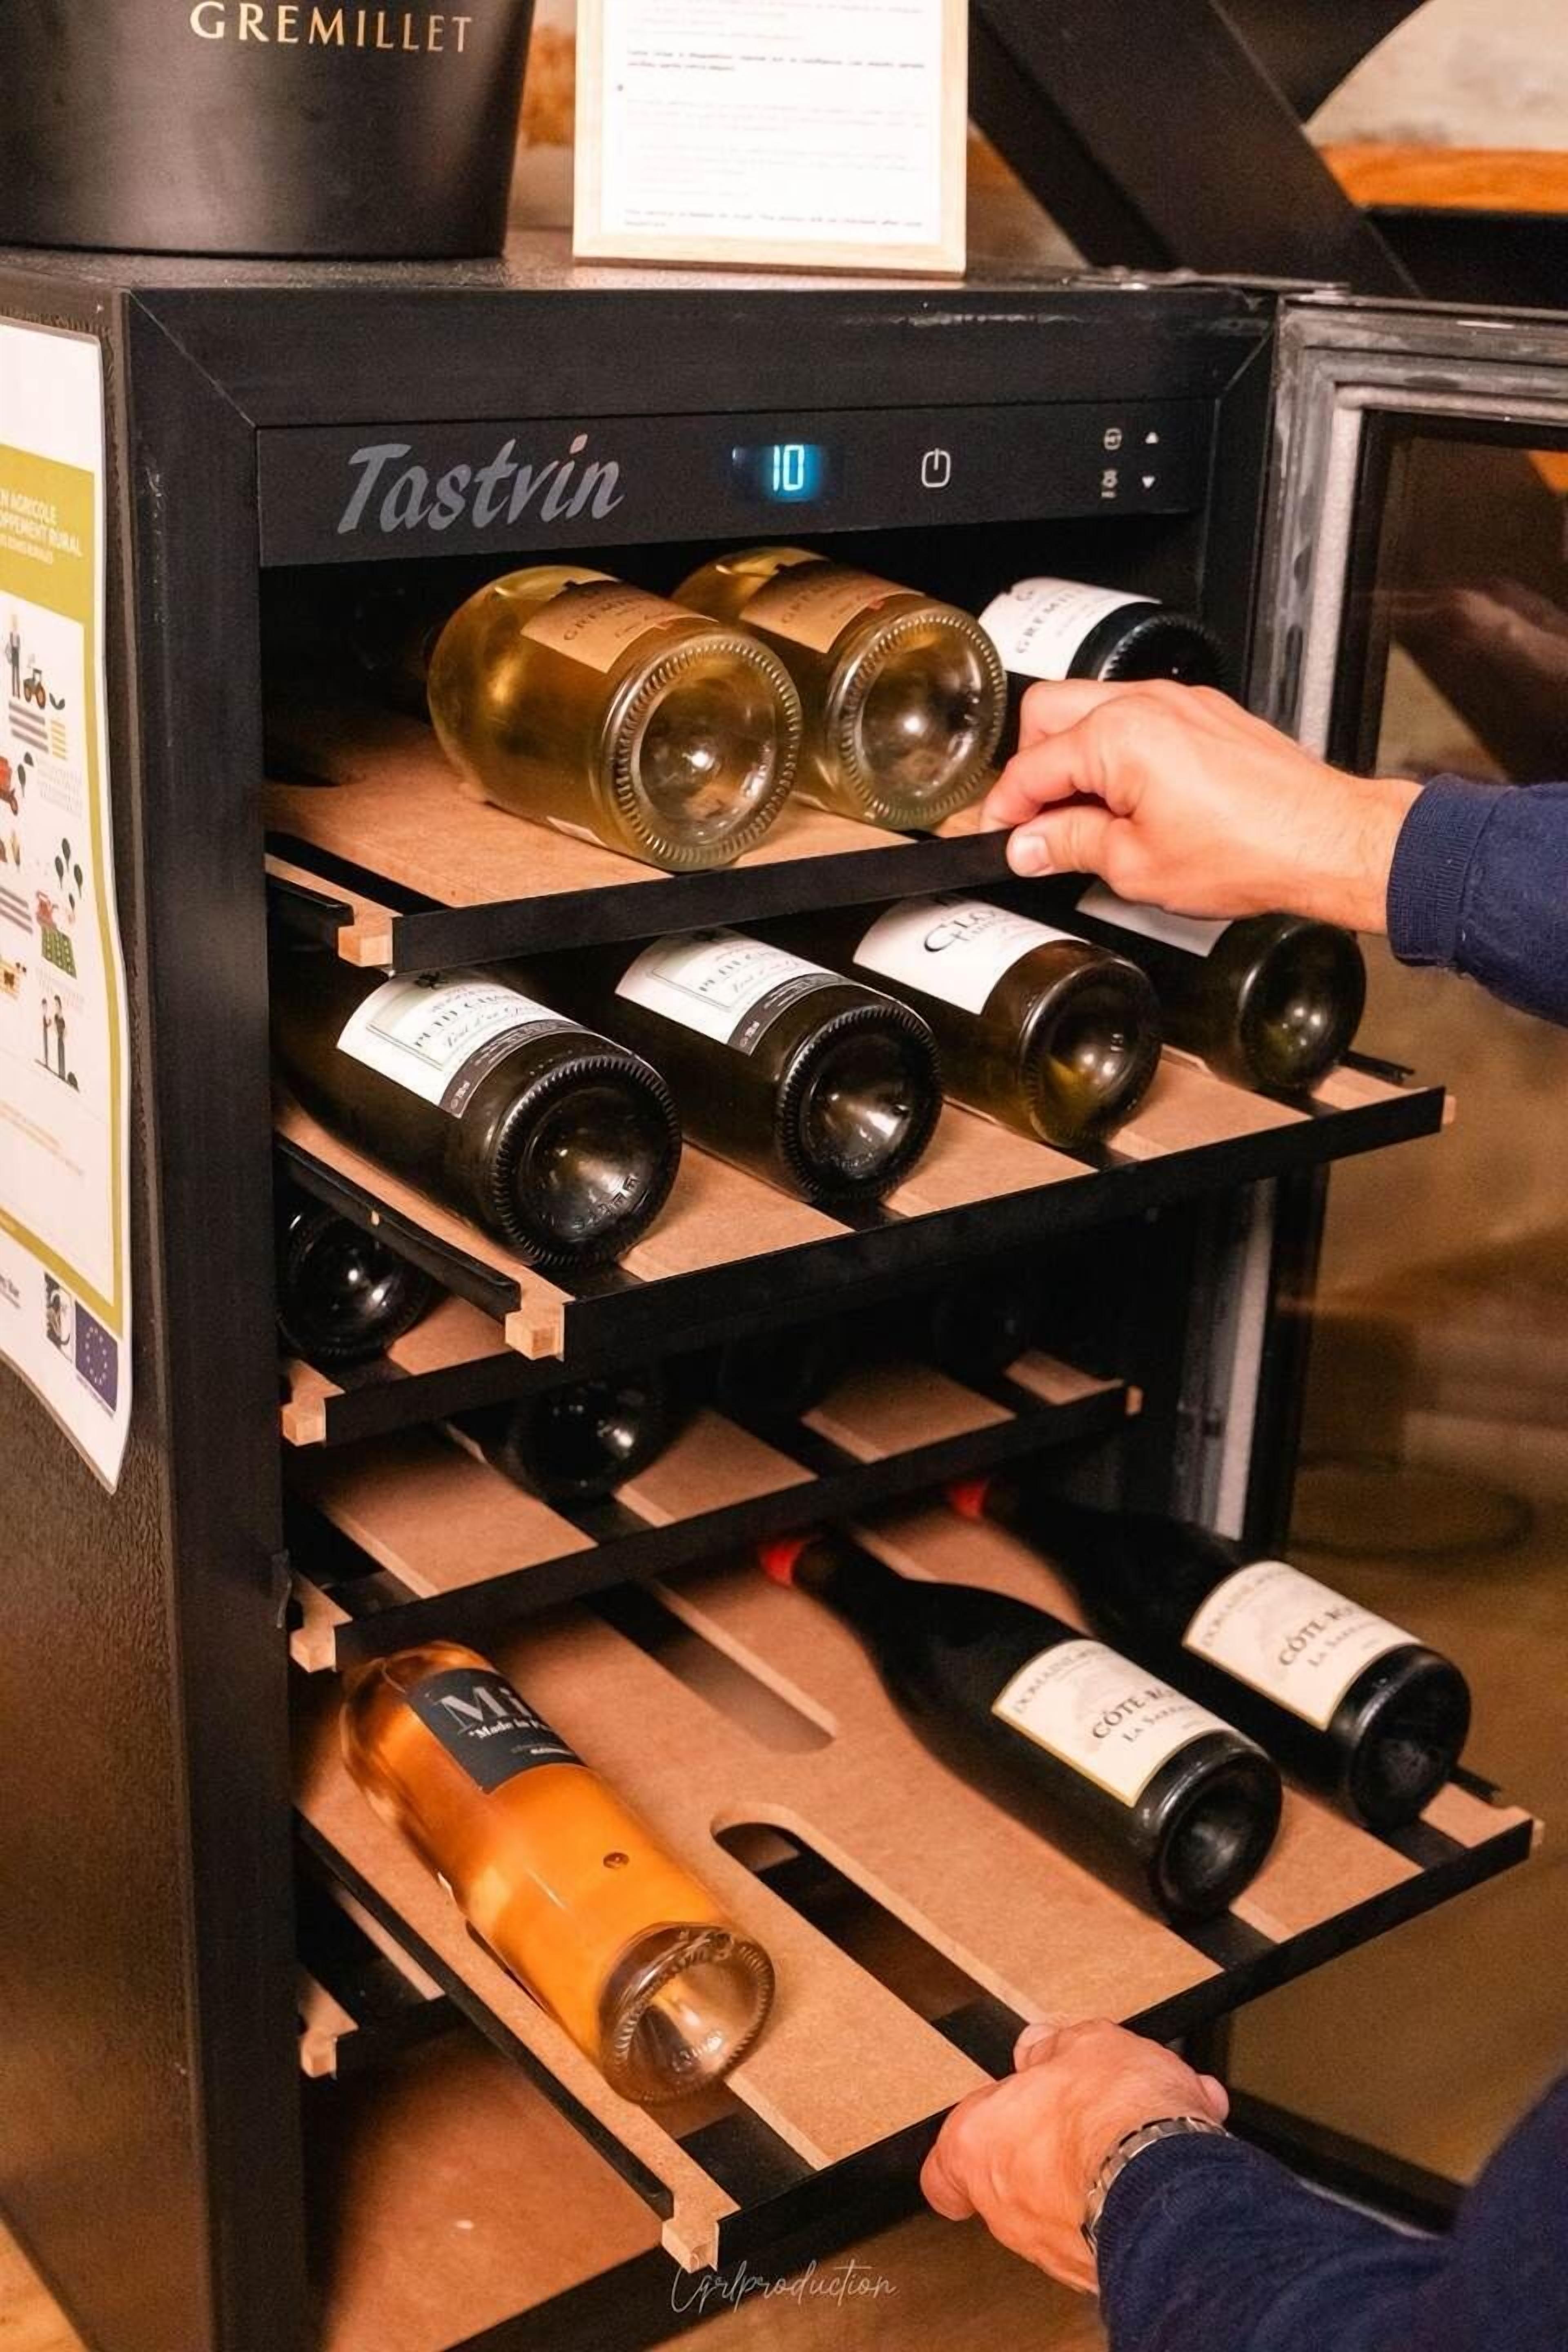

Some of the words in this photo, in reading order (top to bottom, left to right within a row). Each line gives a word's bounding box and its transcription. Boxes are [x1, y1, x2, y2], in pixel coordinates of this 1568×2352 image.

[190, 1, 473, 53] GREMILLET
[337, 434, 625, 534] Tastvin
[773, 445, 804, 492] 10
